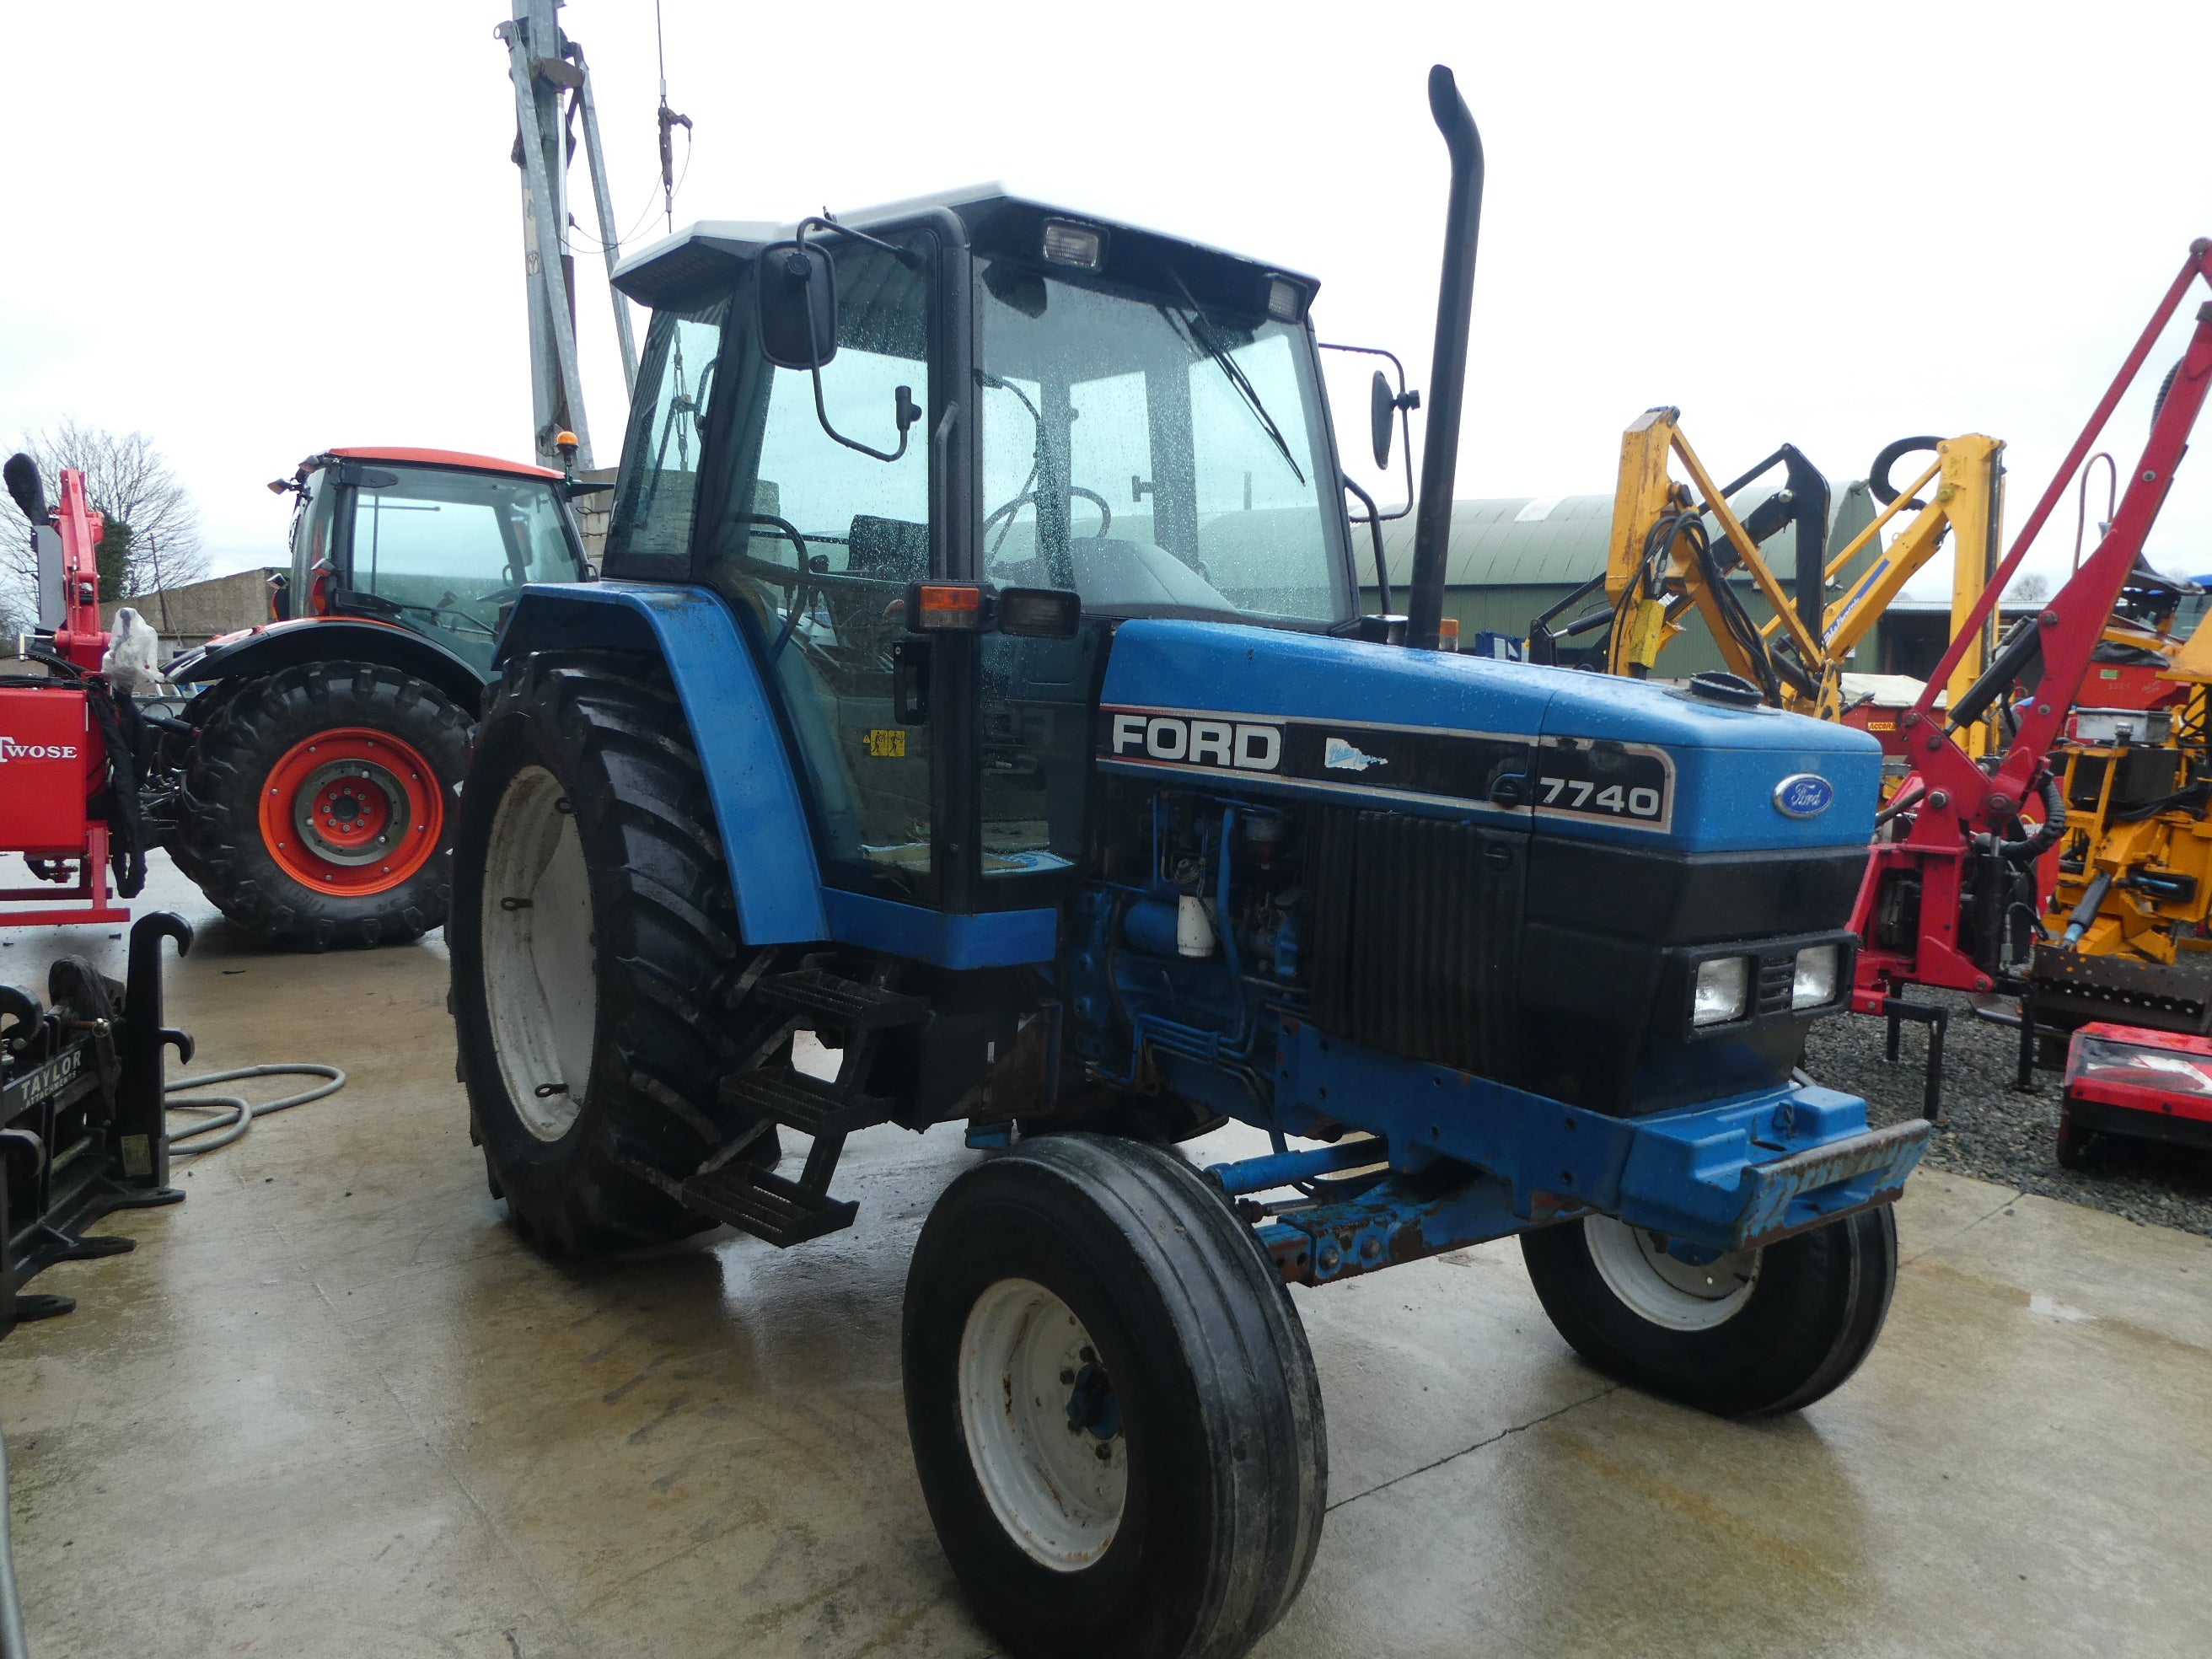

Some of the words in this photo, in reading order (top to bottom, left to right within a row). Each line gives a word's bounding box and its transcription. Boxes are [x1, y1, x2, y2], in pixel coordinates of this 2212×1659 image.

[1113, 714, 1281, 770] FORD
[1539, 776, 1659, 816] 7740
[1791, 783, 1822, 806] Ford
[21, 1050, 82, 1100] TAYLOR
